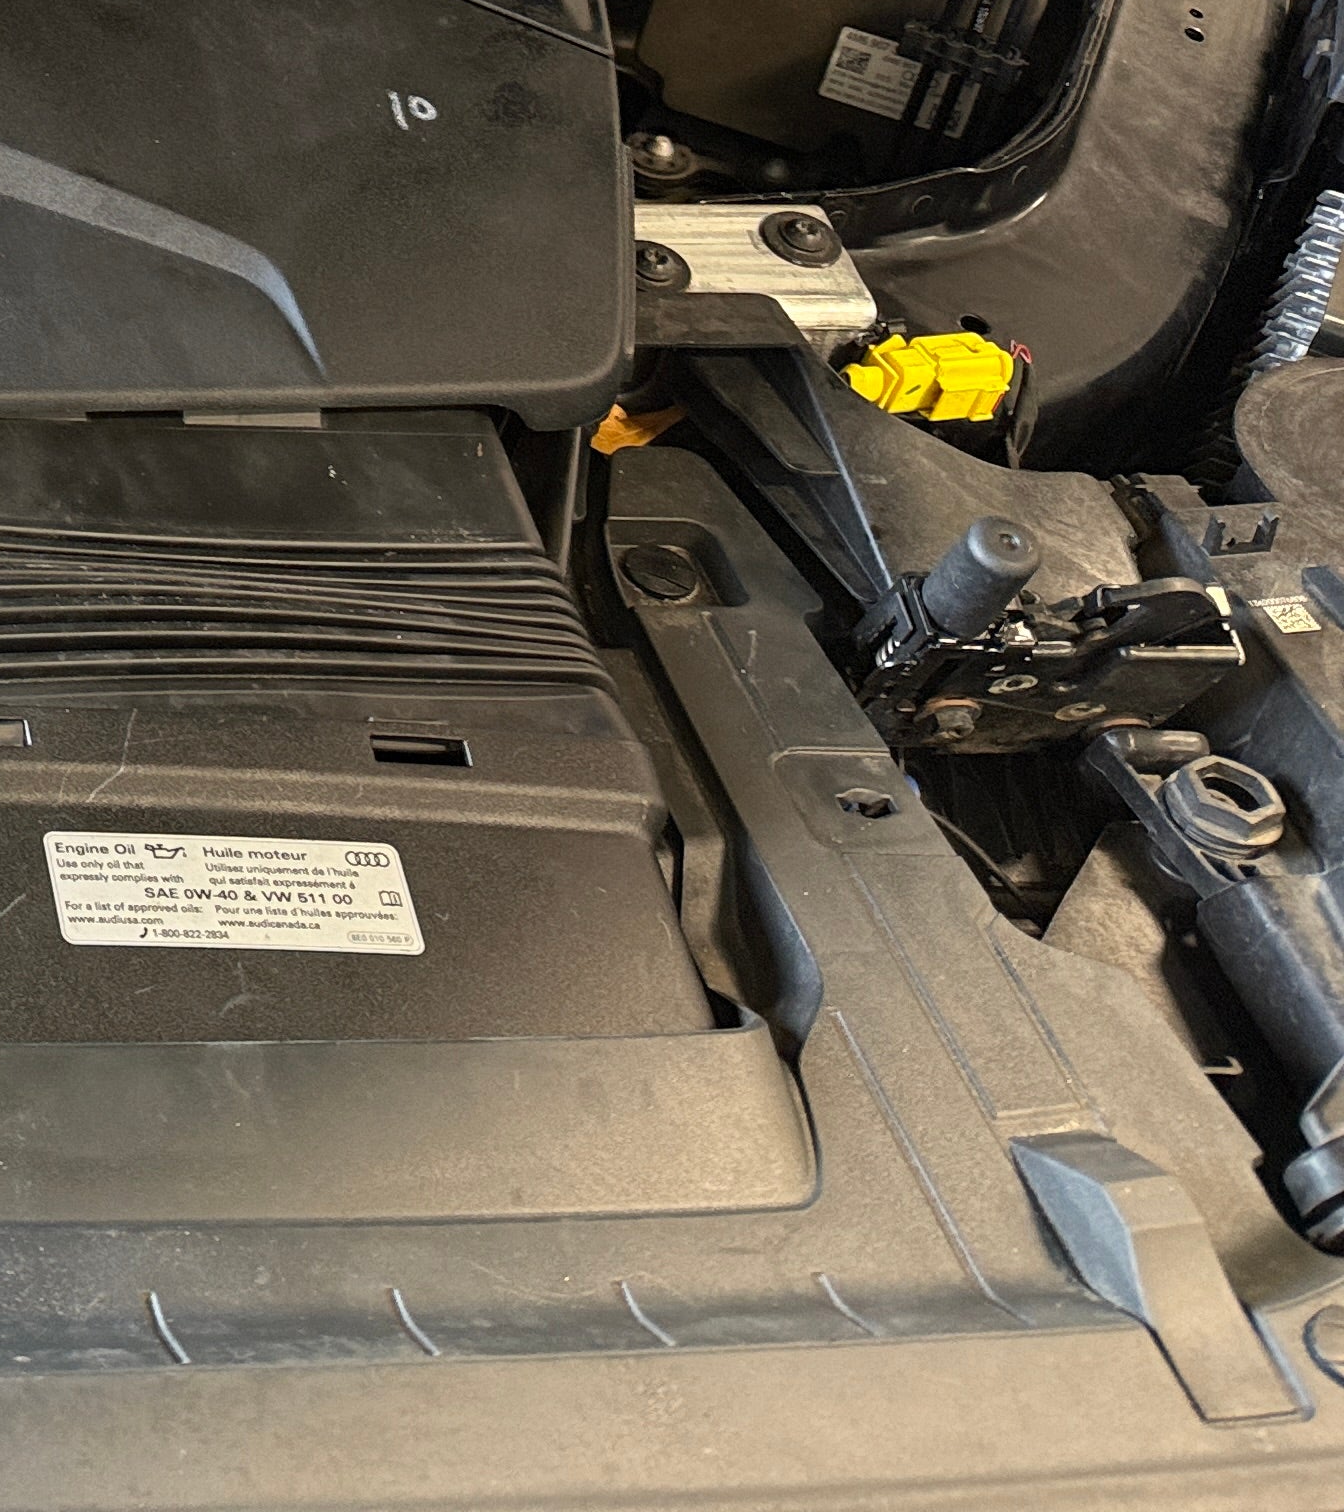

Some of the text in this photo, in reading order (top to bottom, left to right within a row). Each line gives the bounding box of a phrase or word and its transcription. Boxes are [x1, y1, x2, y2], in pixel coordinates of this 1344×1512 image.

[387, 90, 438, 130] 10
[54, 842, 135, 855] Engine Oil
[202, 846, 307, 860] Huile moteur
[55, 858, 144, 870] Use only oil that
[245, 865, 309, 875] uniquement
[311, 866, 325, 876] de
[59, 873, 184, 883] expressly complies with
[208, 876, 226, 885] qui
[144, 887, 352, 905] SAE 0W-40 & VW 511 00
[64, 900, 82, 910] For
[94, 901, 111, 910] list
[113, 902, 124, 911] of
[127, 903, 178, 913] approved
[214, 904, 239, 914] Pour
[242, 907, 263, 915] une
[264, 906, 287, 916] liste
[67, 914, 164, 924] www.audiusa.com
